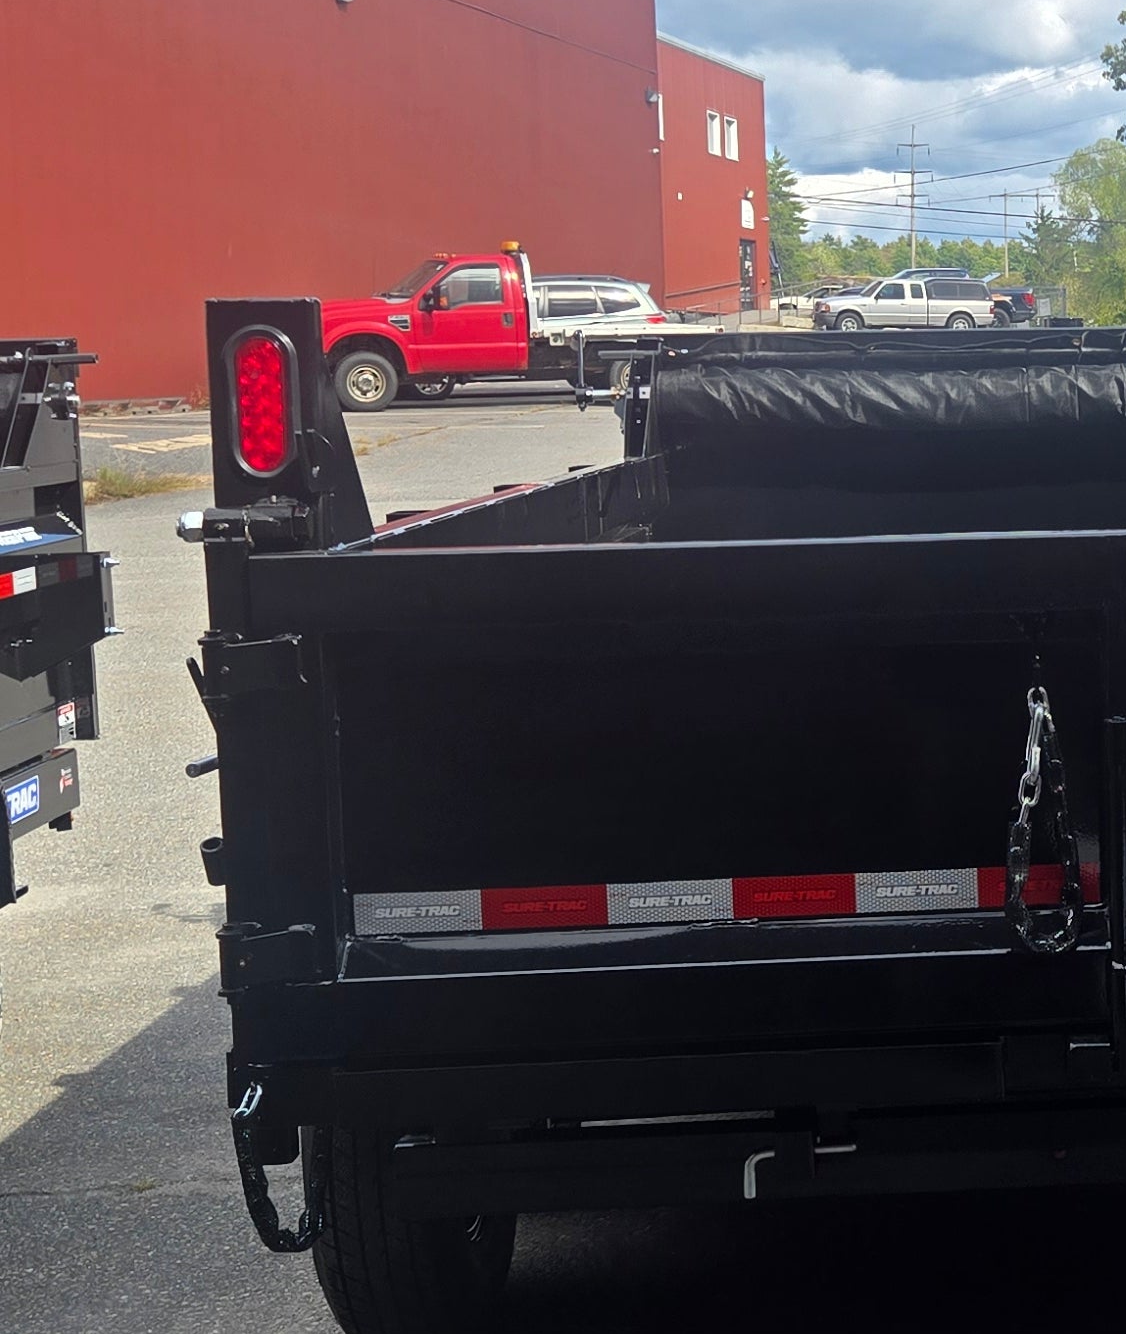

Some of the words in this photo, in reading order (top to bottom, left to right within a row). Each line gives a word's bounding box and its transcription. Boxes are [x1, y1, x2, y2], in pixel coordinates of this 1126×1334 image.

[374, 905, 460, 919] SURE-TRAC
[502, 901, 587, 913] SURE-TRAC
[629, 894, 712, 908] SURE-TRAC
[754, 889, 836, 902] SURE-TRAC
[876, 884, 958, 898] SURE-TRAC
